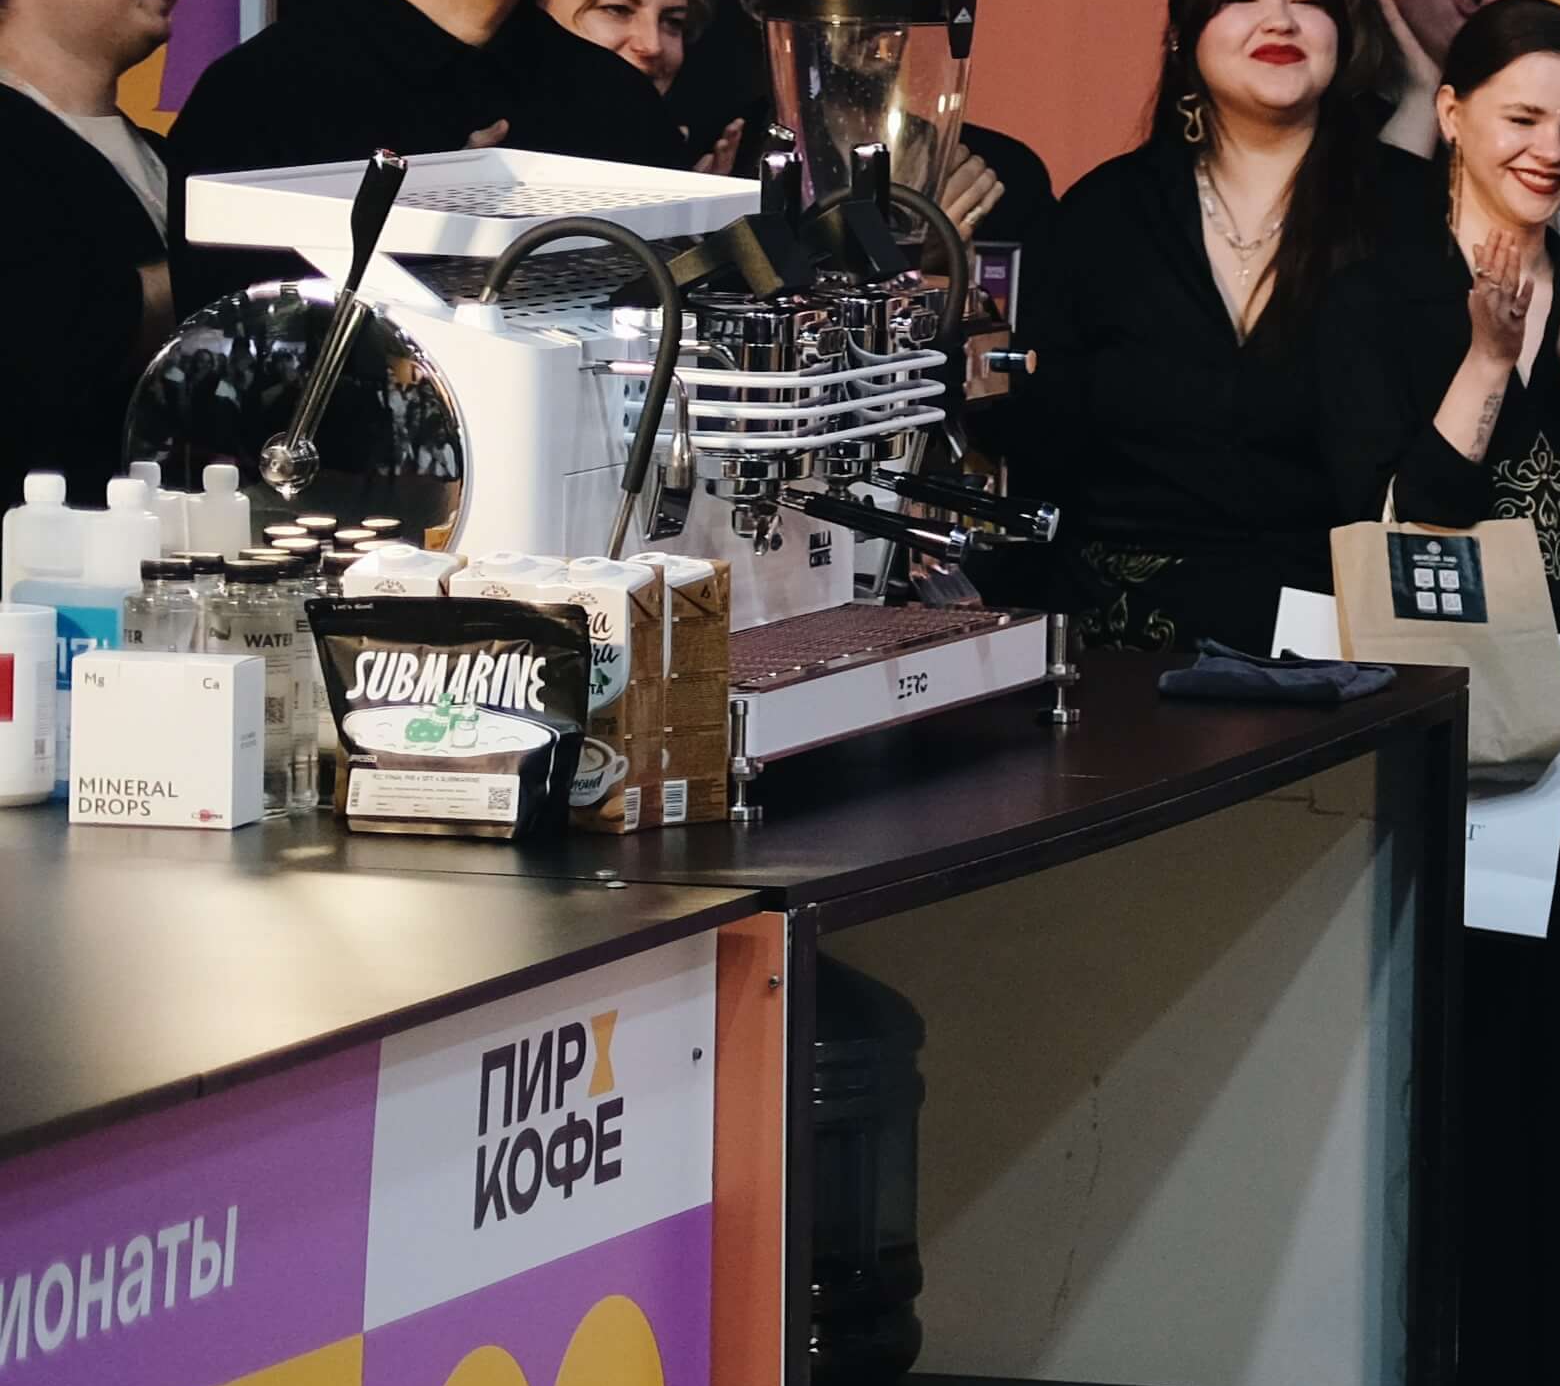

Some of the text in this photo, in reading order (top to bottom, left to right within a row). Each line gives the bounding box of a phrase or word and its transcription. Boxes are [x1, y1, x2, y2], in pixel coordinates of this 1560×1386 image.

[84, 673, 104, 688] Mg
[202, 678, 220, 690] Ca
[345, 650, 547, 712] SUBMARINE
[79, 777, 179, 798] MINERAL
[78, 798, 151, 817] DROPS
[477, 1022, 587, 1136] ПИР
[472, 1098, 624, 1230] КОФЕ
